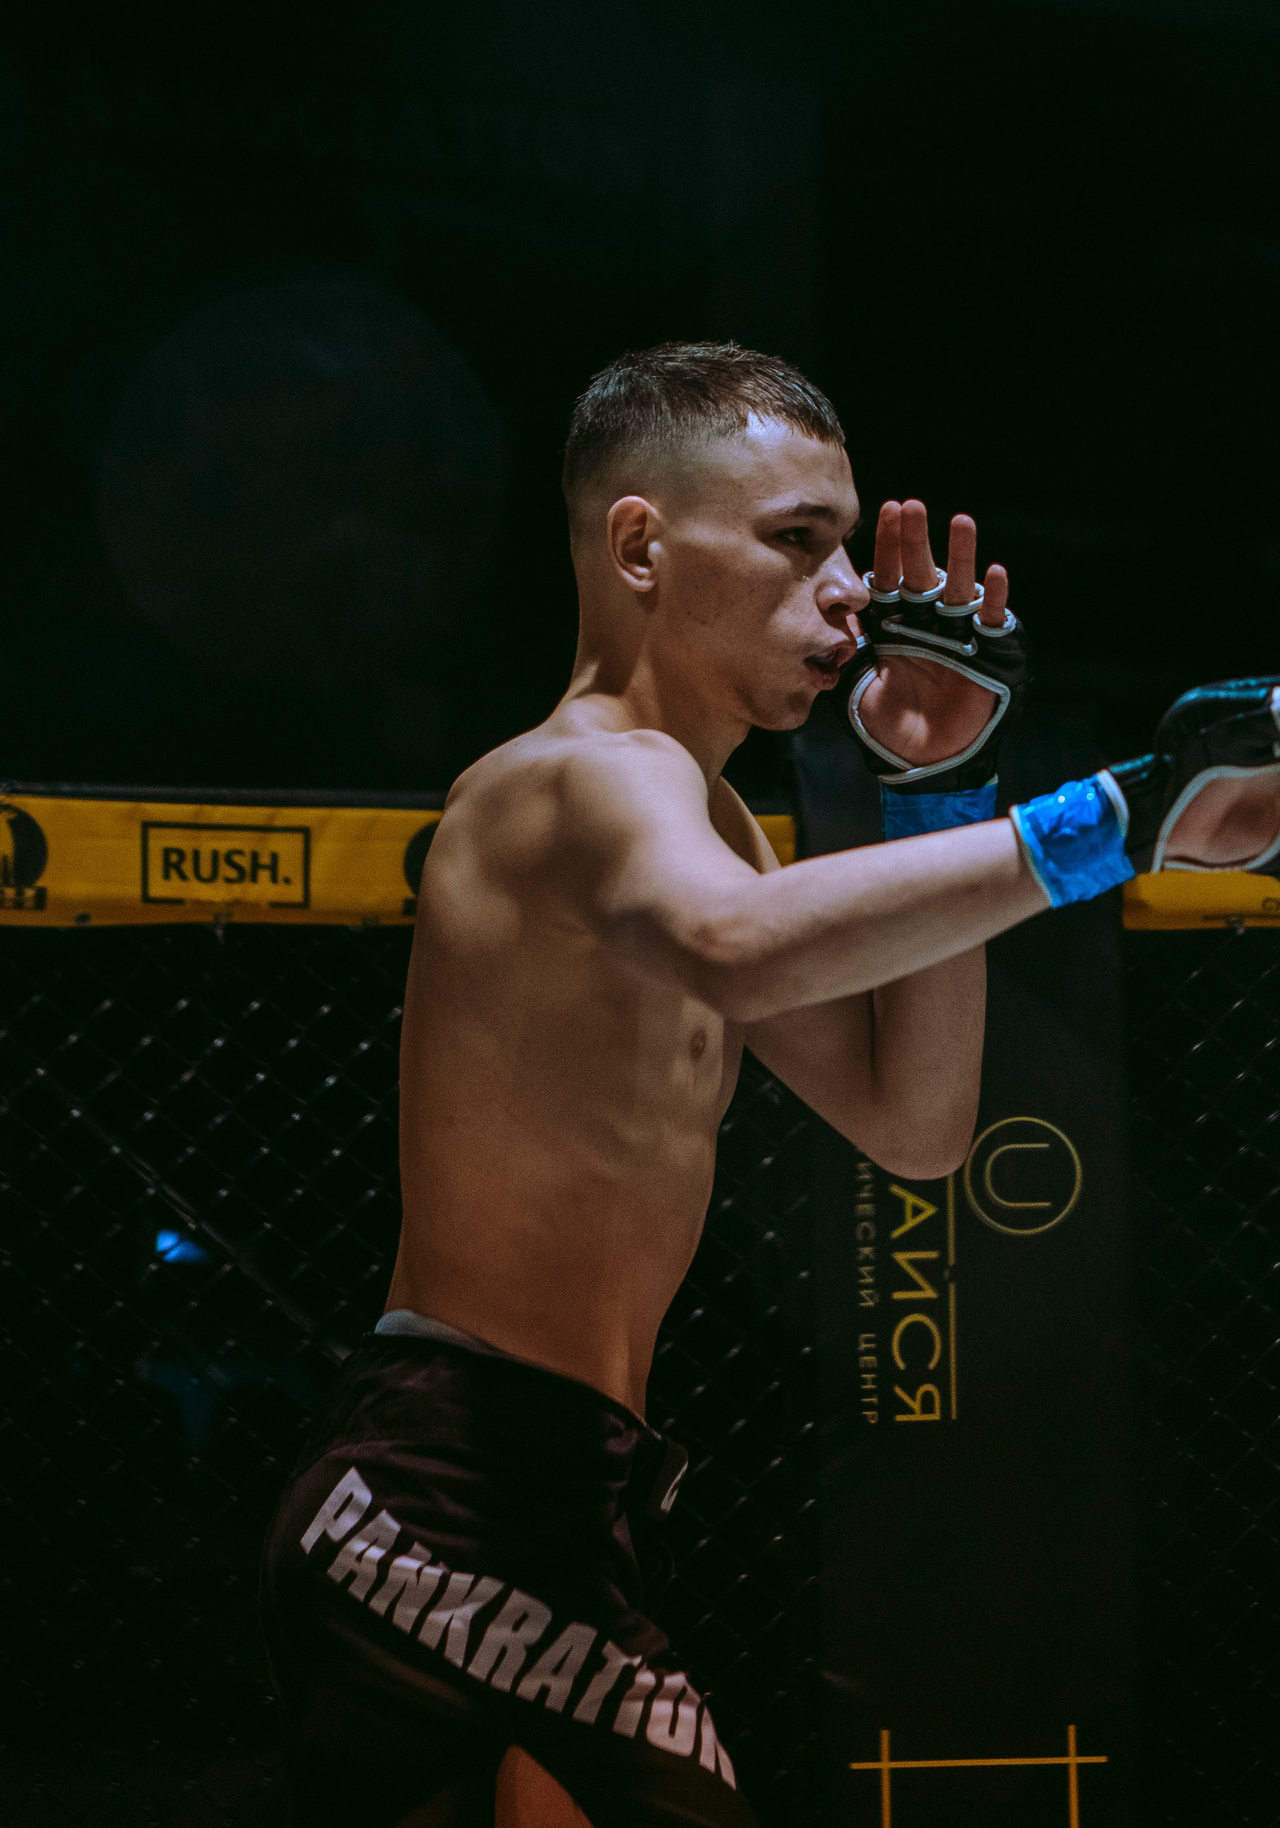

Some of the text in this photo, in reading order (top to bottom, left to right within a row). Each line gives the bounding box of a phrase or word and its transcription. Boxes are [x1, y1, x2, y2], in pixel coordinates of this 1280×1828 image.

[162, 846, 292, 885] RUSH.
[853, 1158, 880, 1425] ИЧЕСКИЙ ЦЕНТР
[889, 1182, 949, 1423] АЙСЯ
[300, 1465, 737, 1791] PANKRATION
